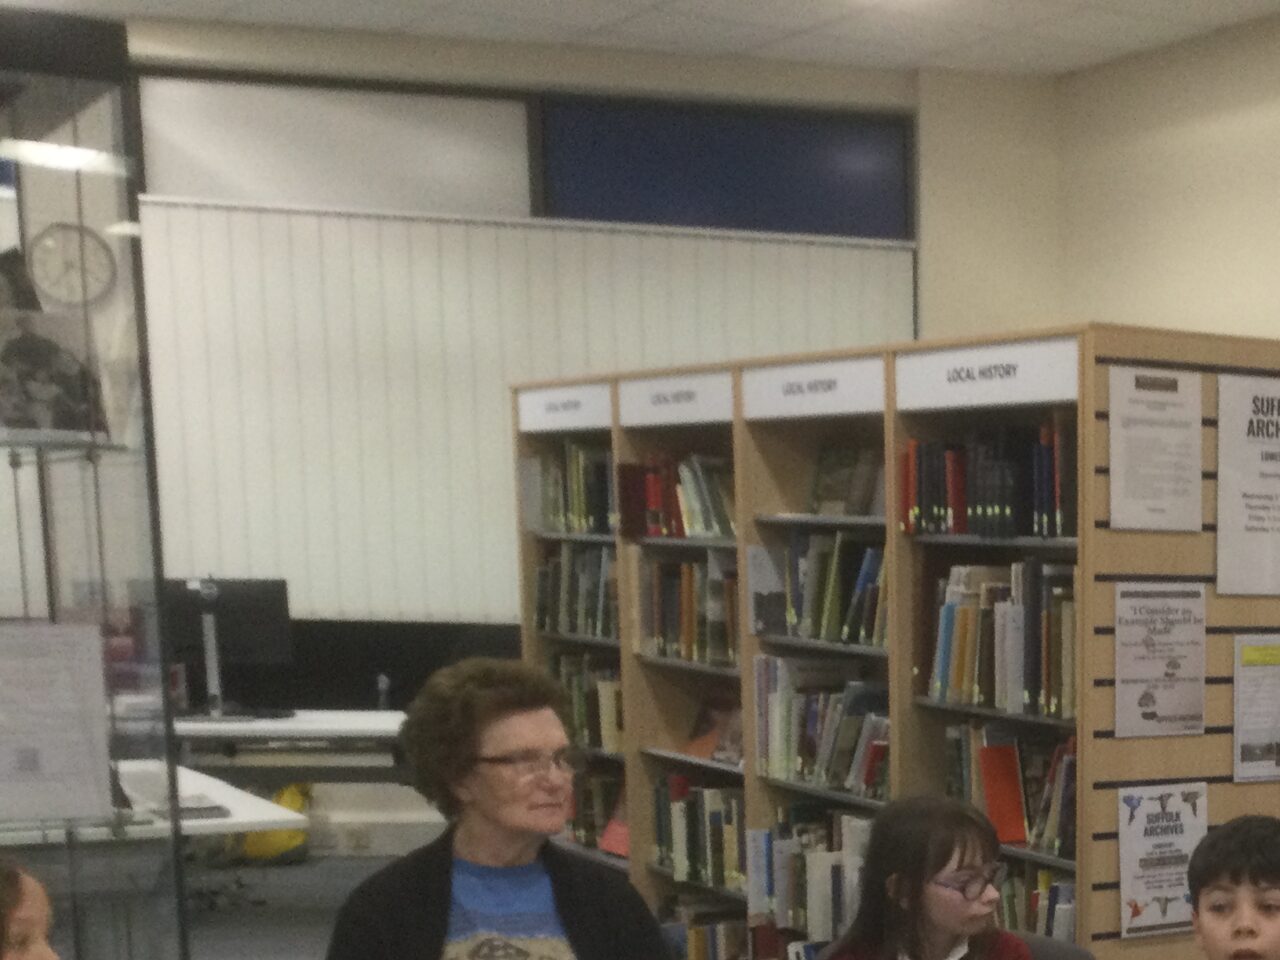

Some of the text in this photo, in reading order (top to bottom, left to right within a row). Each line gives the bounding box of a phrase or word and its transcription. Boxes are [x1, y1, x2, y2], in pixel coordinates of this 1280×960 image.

[947, 363, 1018, 383] LOCAL HISTORY
[782, 377, 838, 397] LOCAL HISTORY
[1145, 811, 1181, 825] SUFFOLK
[1143, 823, 1184, 838] ARCHIVES
